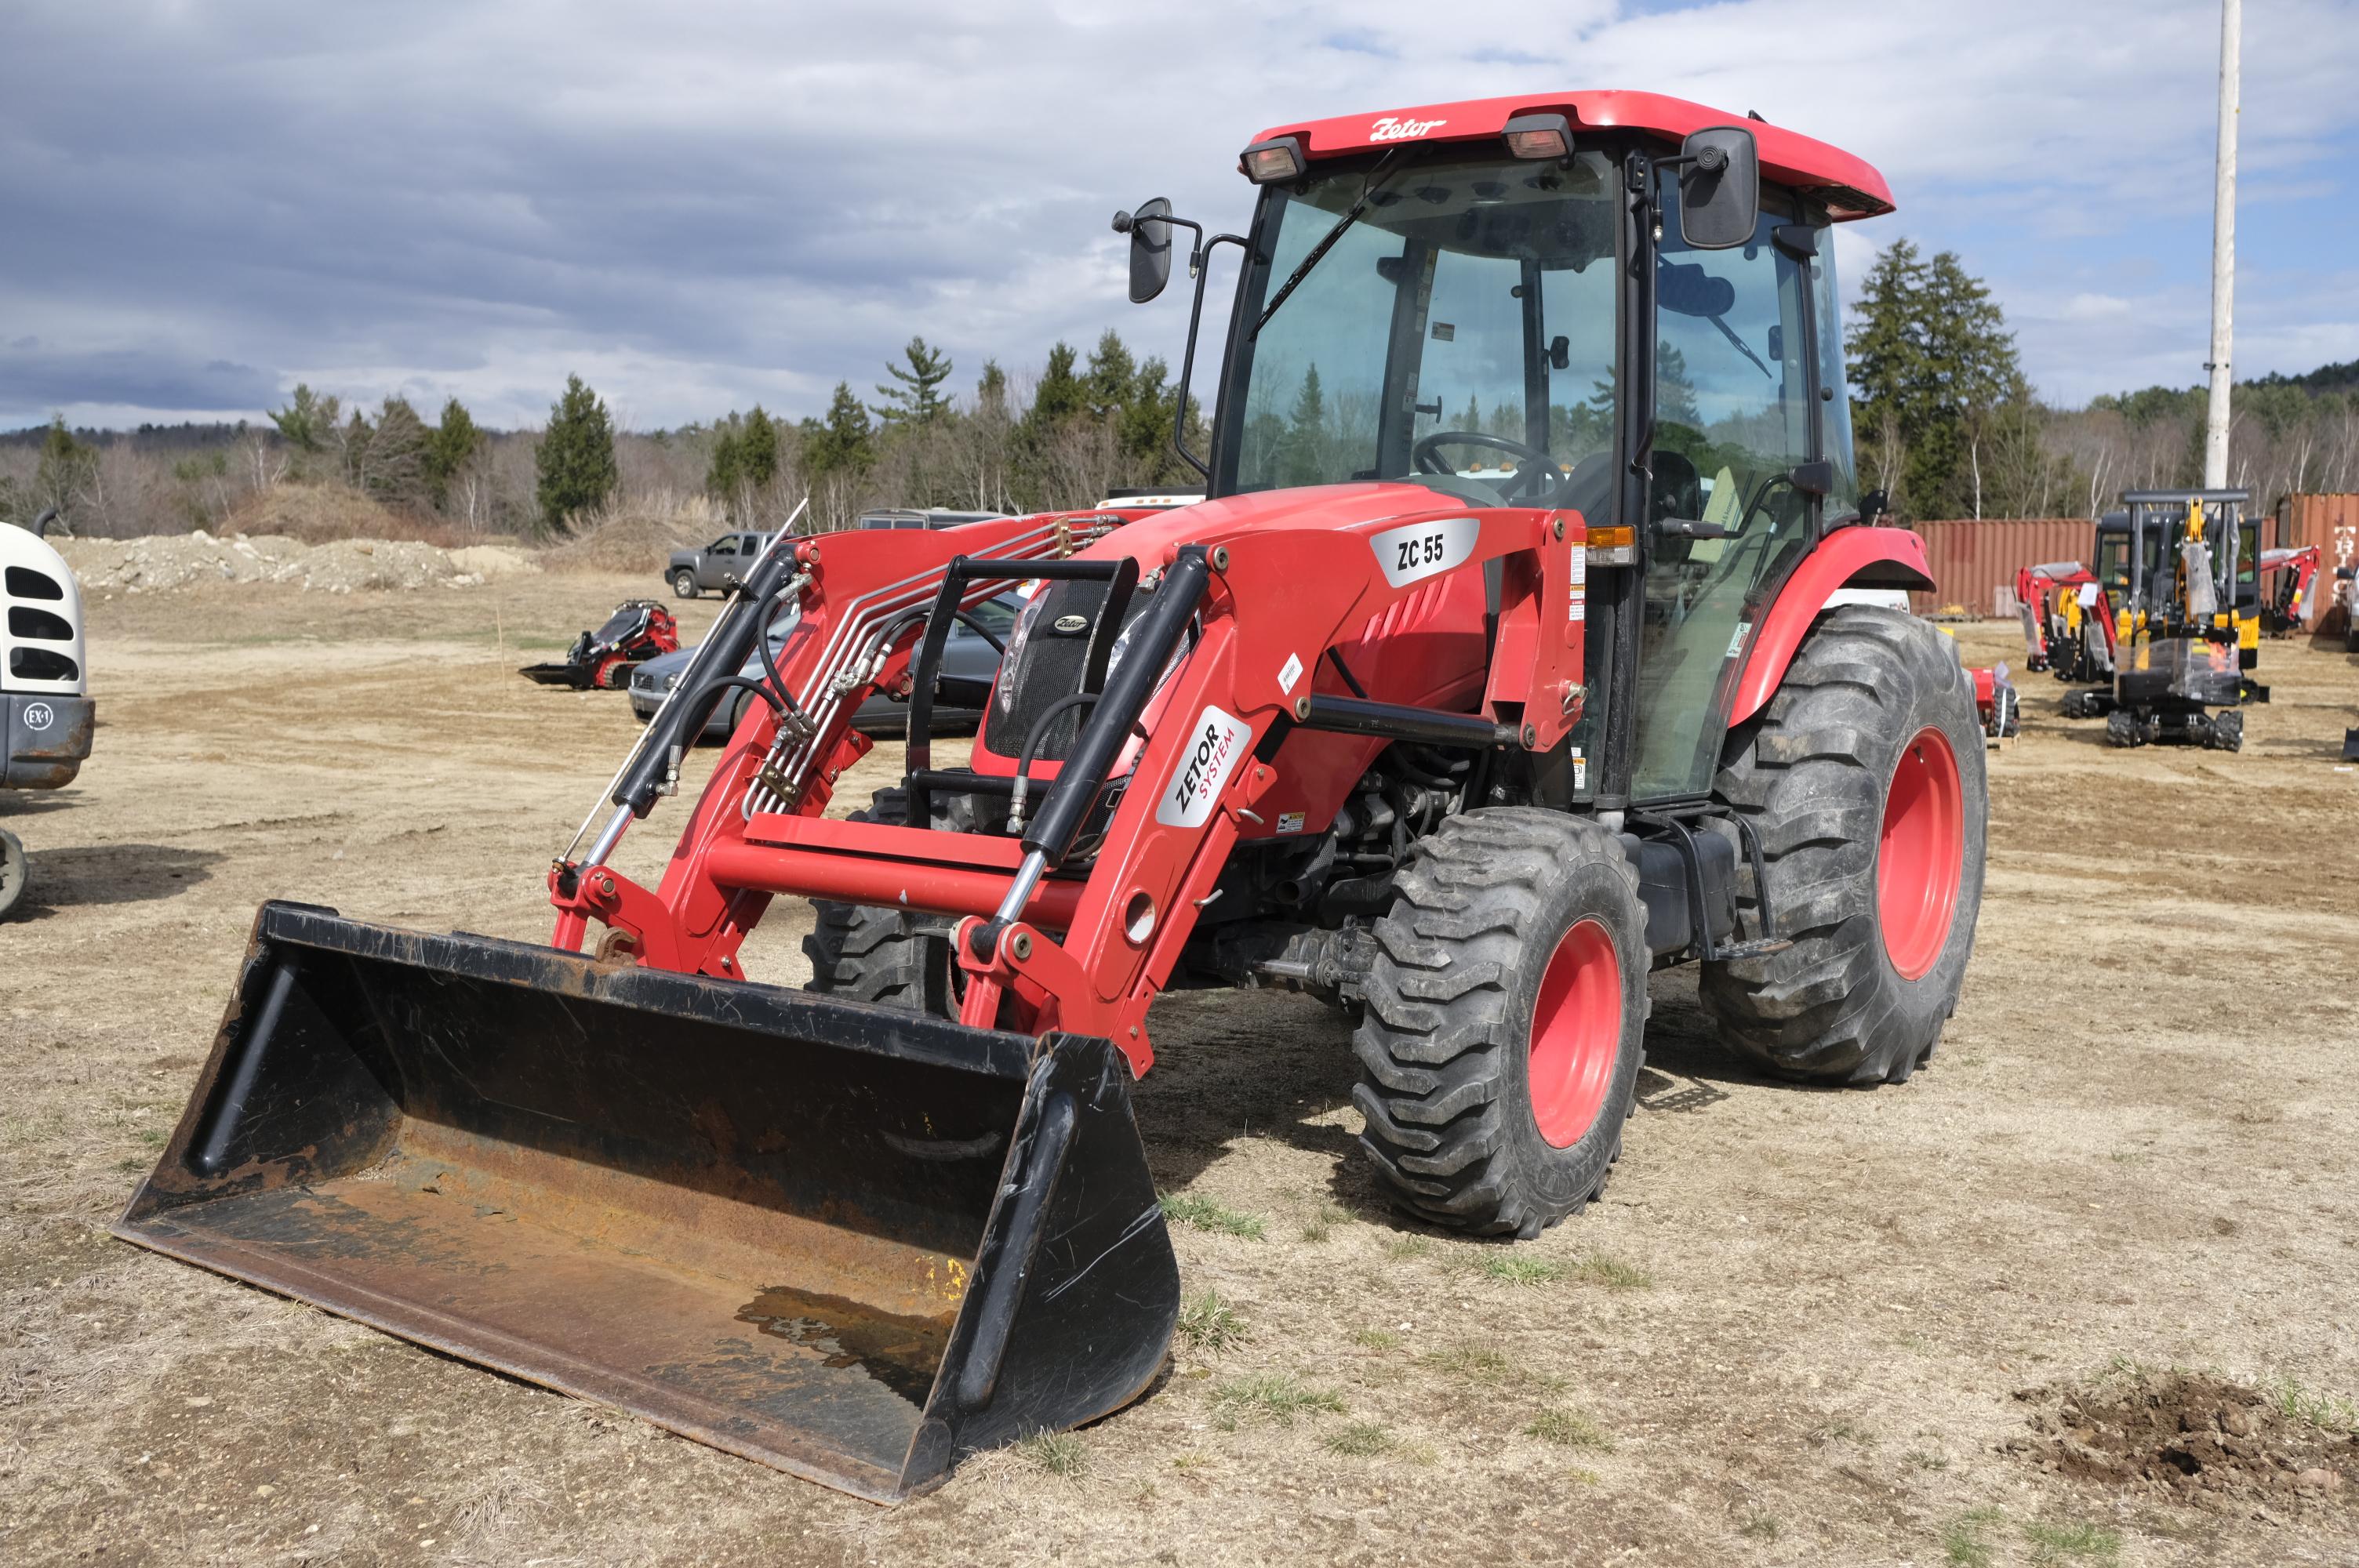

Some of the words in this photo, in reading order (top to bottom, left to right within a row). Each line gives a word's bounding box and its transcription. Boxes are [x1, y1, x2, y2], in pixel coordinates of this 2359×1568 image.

[1370, 118, 1447, 141] Zetor
[1398, 541, 1419, 571] ZC
[1424, 533, 1444, 564] 55
[1057, 618, 1087, 628] Zetor
[1176, 724, 1219, 815] ZETOR
[1199, 726, 1235, 800] SYSTEM
